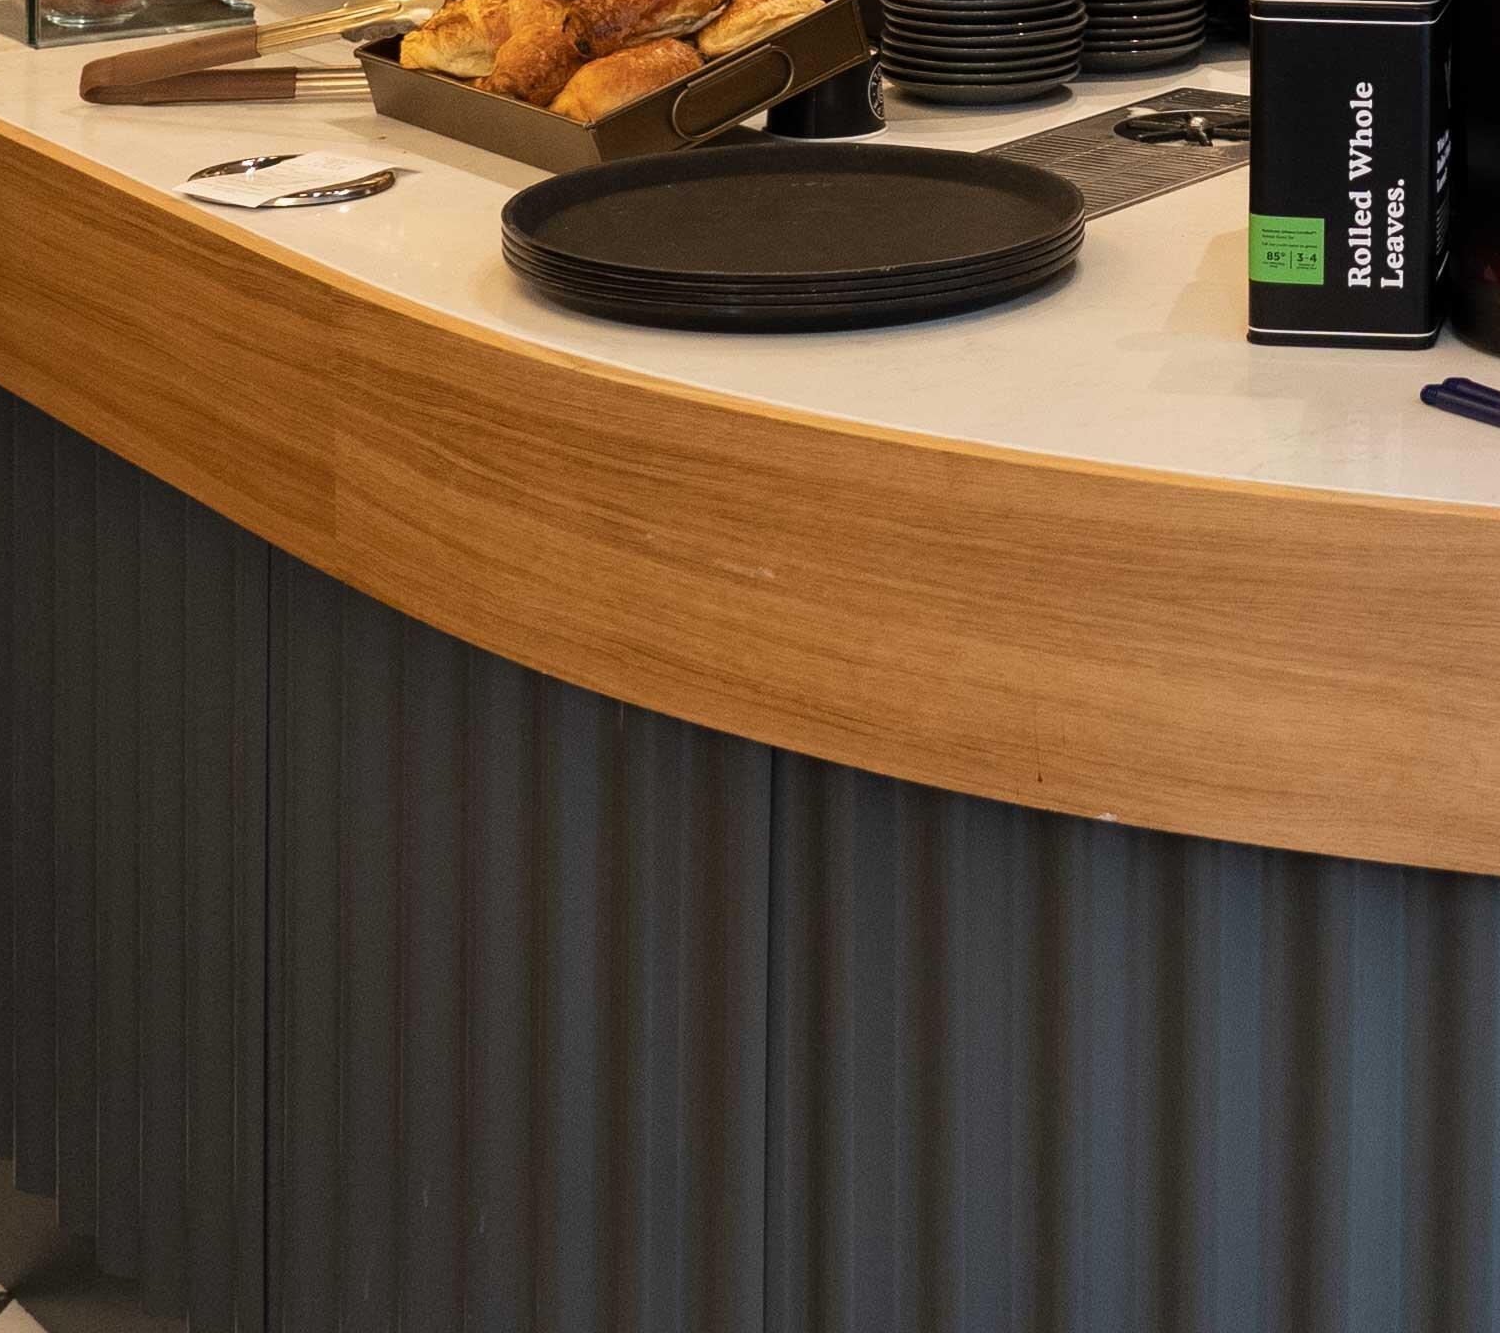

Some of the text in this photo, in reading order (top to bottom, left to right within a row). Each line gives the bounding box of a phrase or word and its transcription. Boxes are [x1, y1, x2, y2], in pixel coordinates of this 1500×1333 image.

[1348, 81, 1373, 288] Rolled Whole
[1380, 178, 1405, 290] Leaves.
